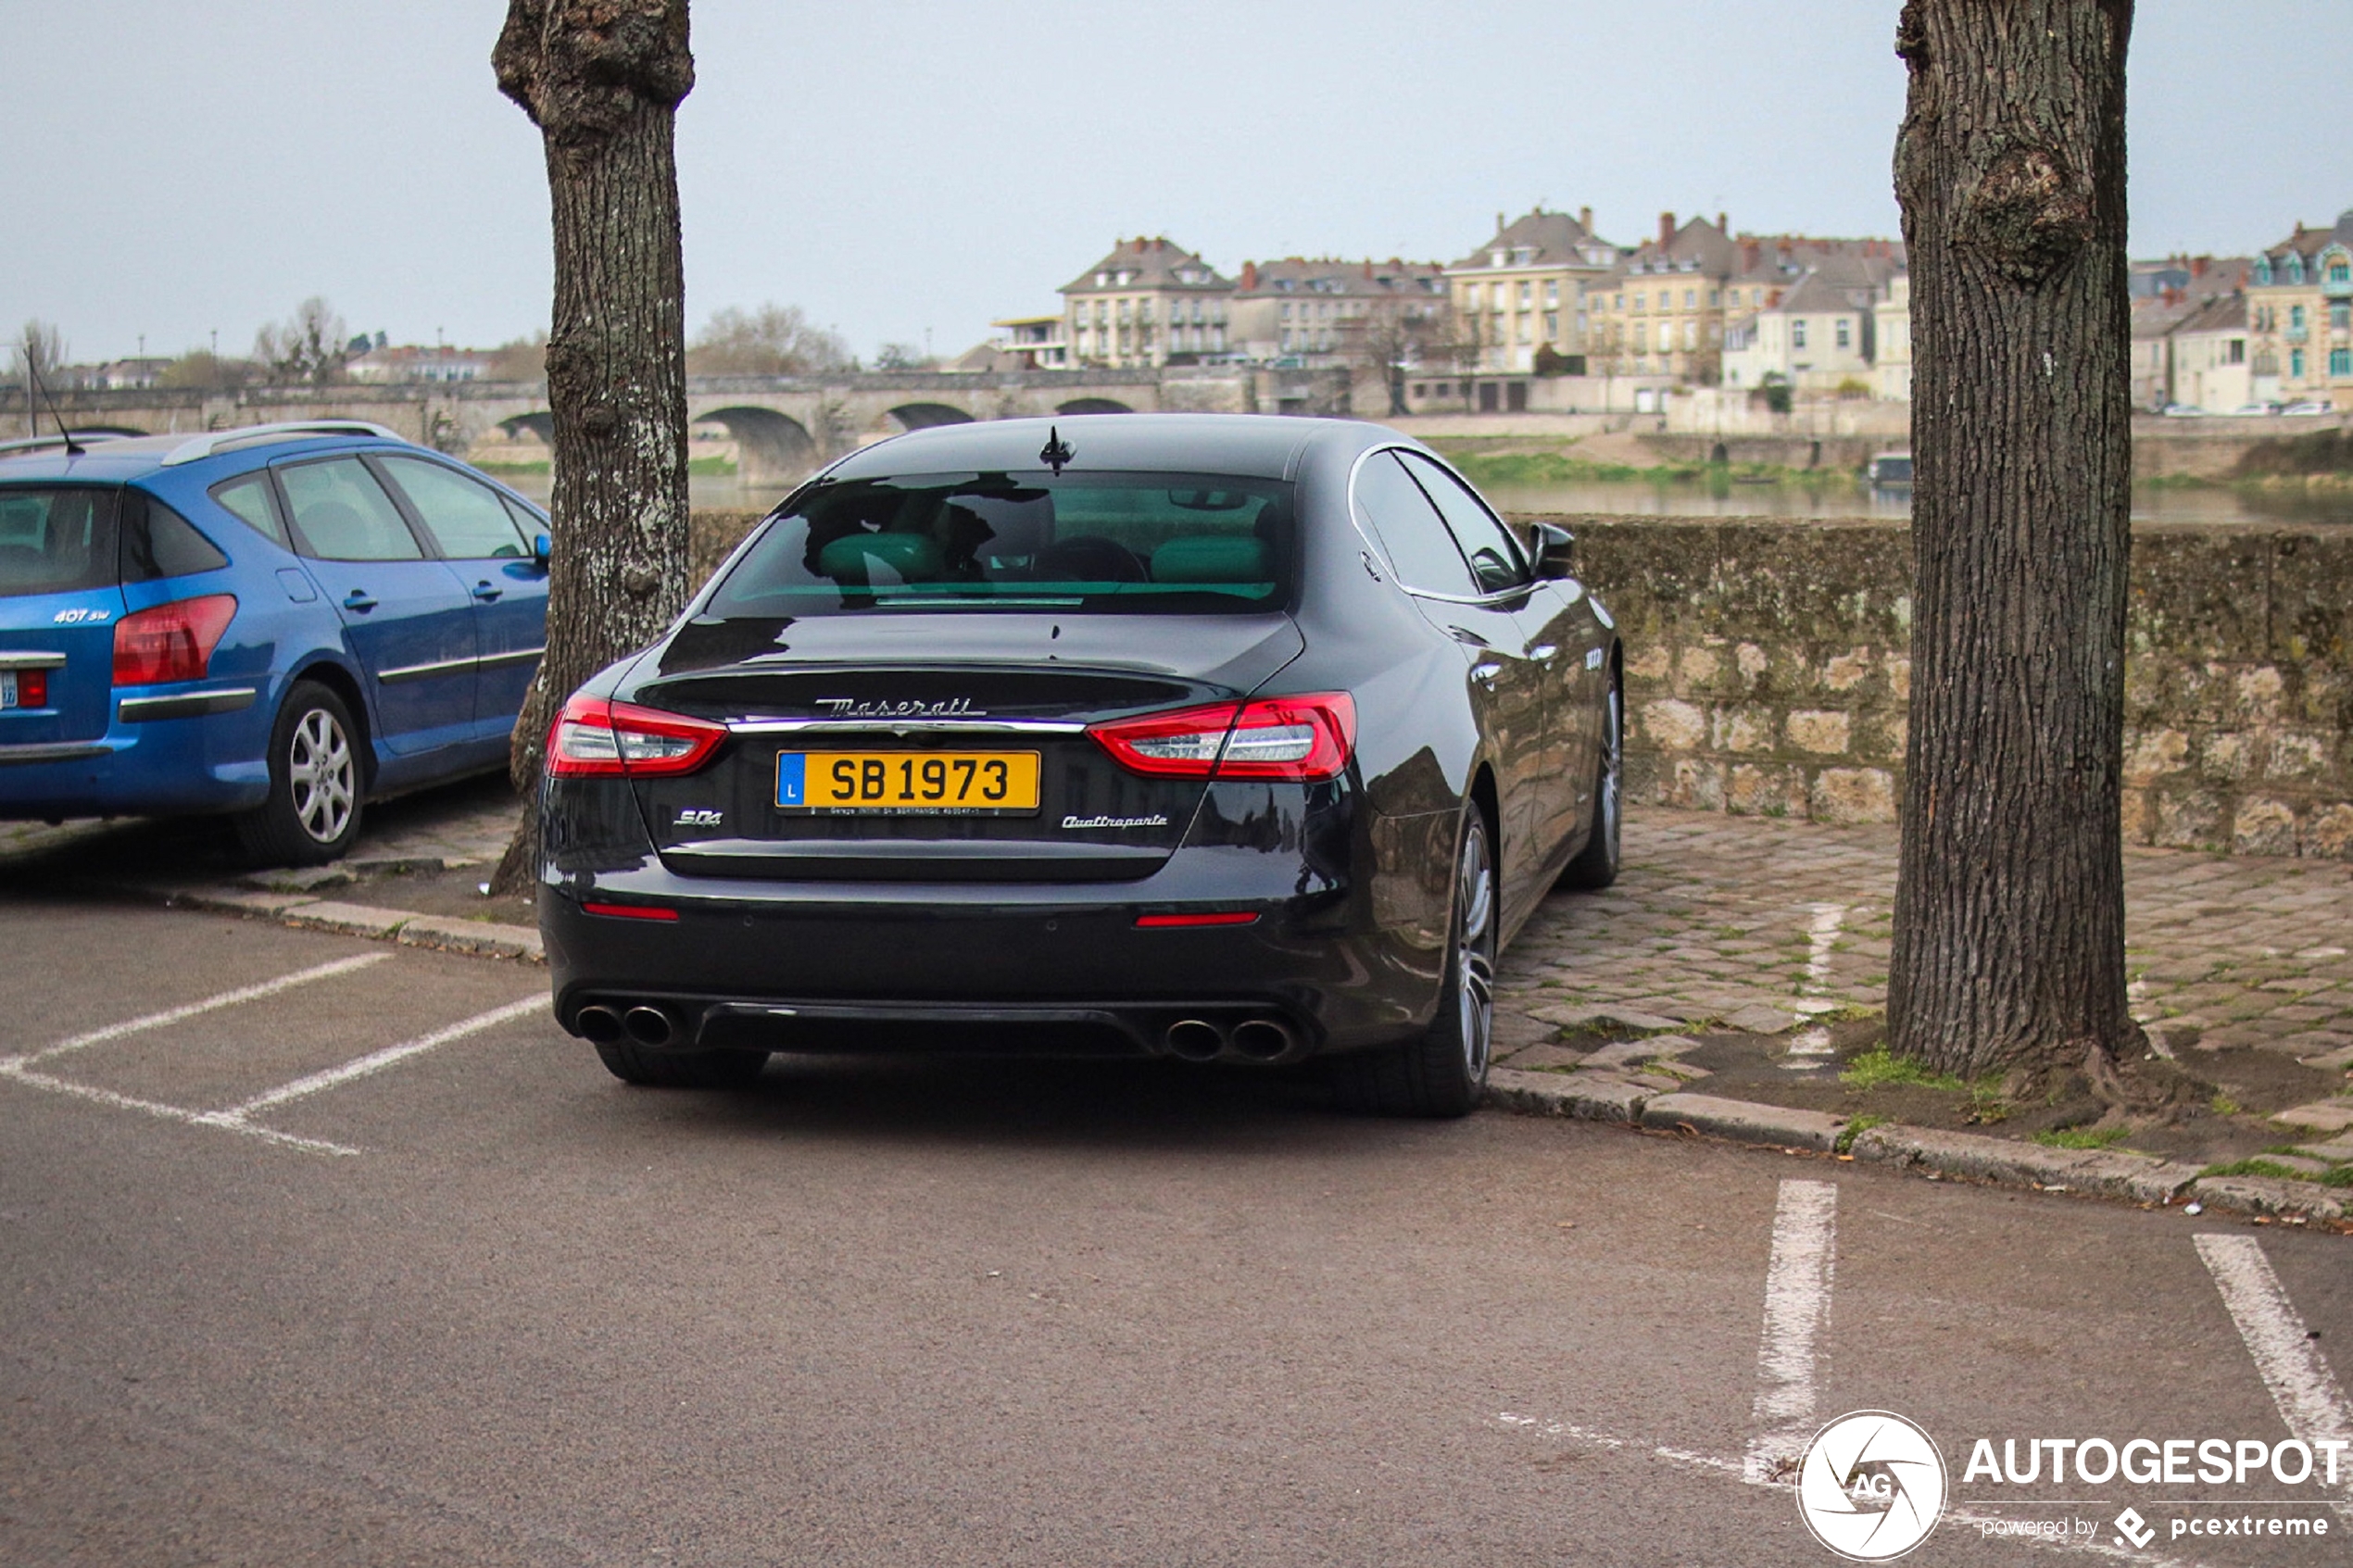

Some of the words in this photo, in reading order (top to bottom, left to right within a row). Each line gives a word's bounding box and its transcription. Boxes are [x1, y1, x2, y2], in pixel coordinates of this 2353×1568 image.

[54, 608, 89, 624] 407
[815, 697, 988, 718] Maserati
[899, 759, 1008, 800] 1973
[787, 784, 796, 798] L
[1062, 814, 1167, 831] Quattroporte
